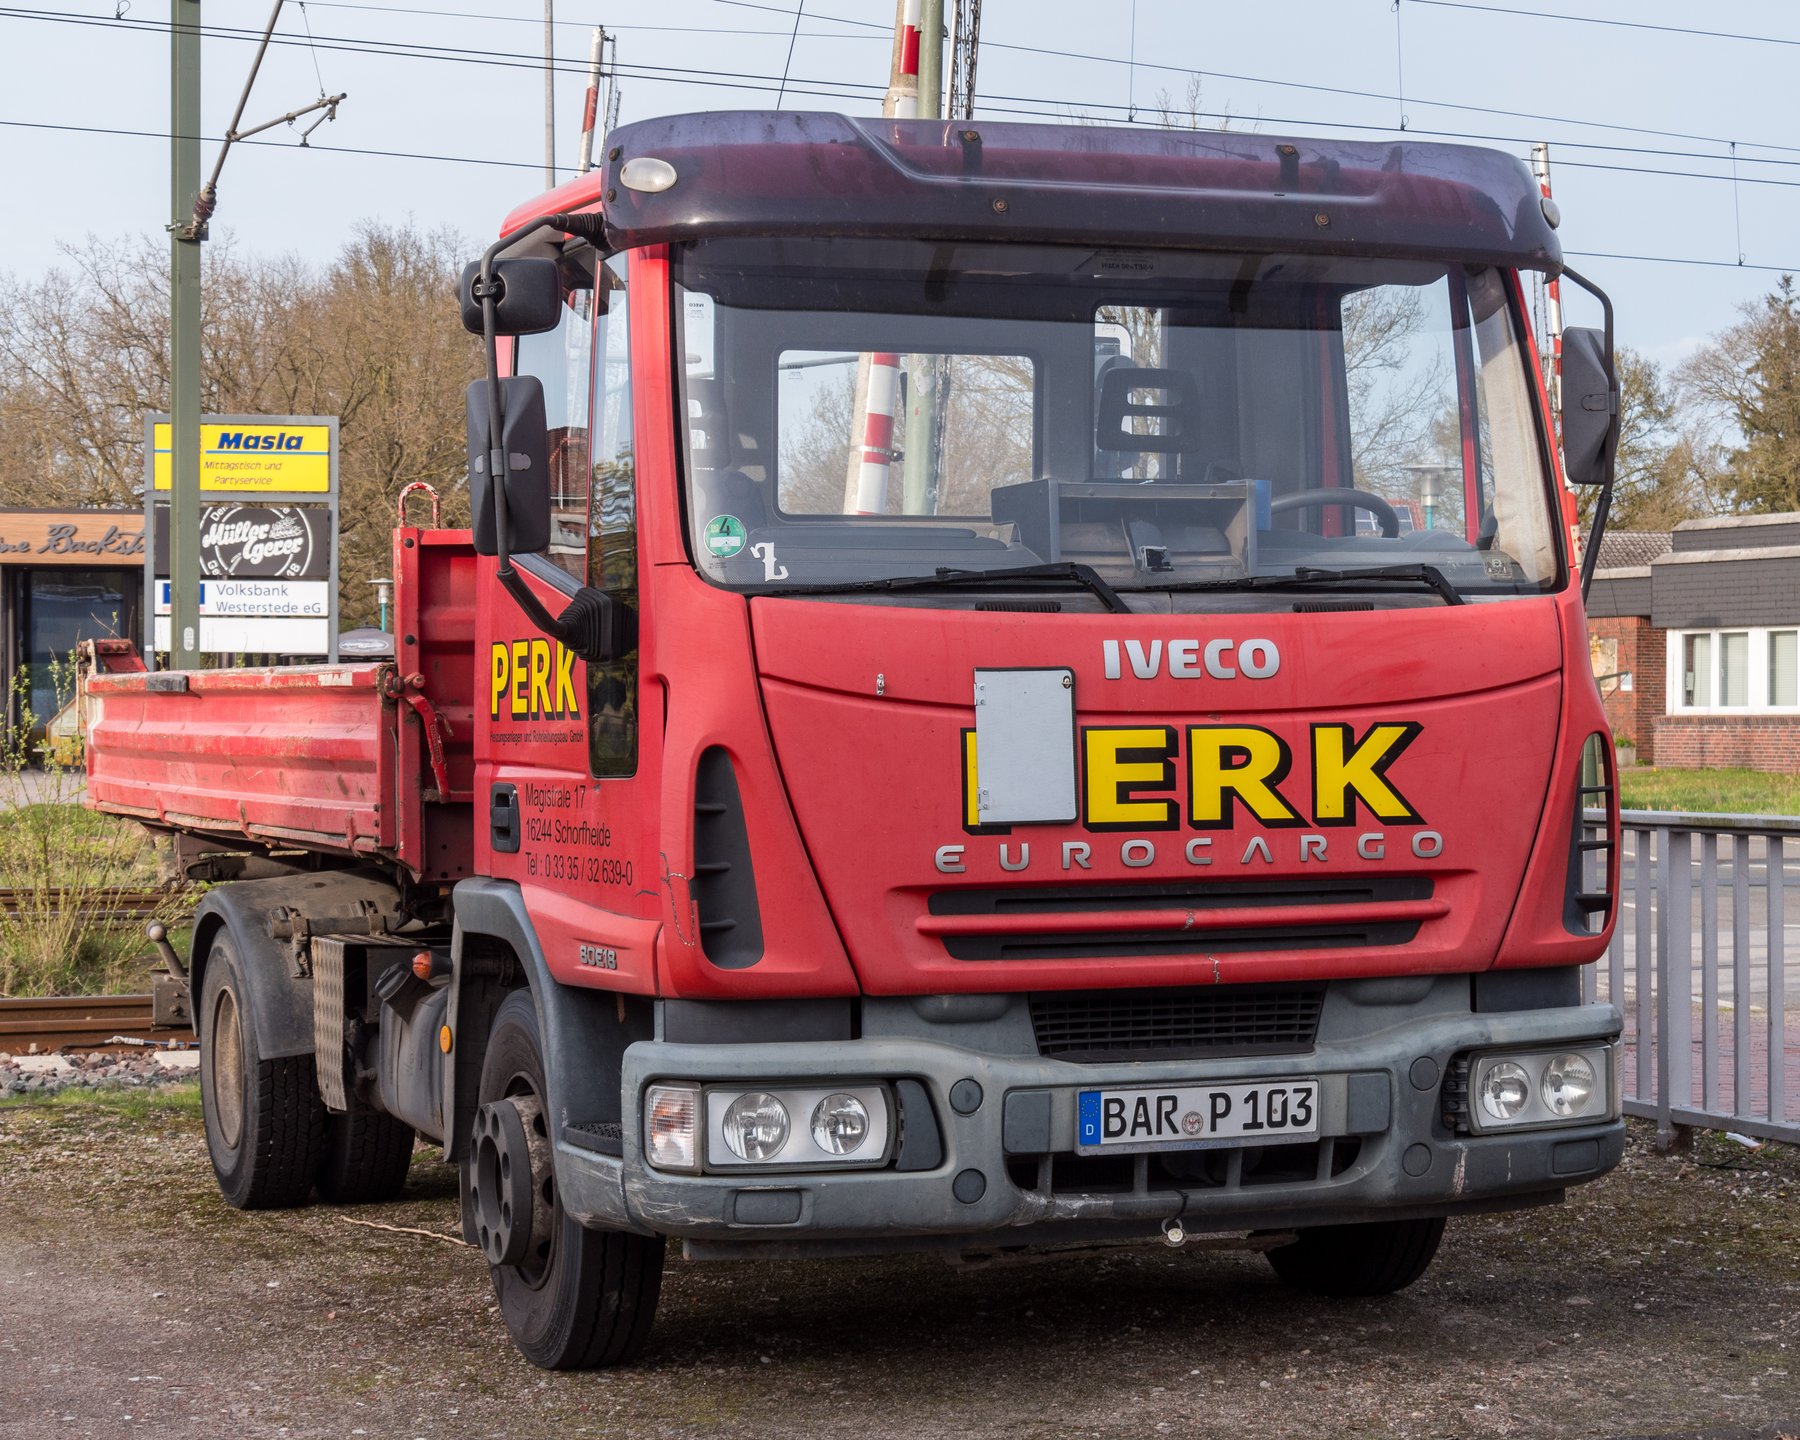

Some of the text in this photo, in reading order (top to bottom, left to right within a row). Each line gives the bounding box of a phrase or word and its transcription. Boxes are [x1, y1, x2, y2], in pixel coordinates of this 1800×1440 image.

[217, 432, 304, 450] Masla
[204, 461, 282, 471] Mittagstisch und
[214, 476, 273, 485] Partyservice
[202, 521, 270, 548] Müller
[719, 517, 731, 536] 4
[216, 584, 289, 596] Volksbank
[216, 601, 320, 613] Westerstede eG
[1102, 638, 1281, 680] IVECO
[491, 638, 581, 721] PERK
[961, 721, 1428, 836] ERK
[525, 783, 586, 813] Magistrale 17
[526, 818, 611, 847] 16244 Schorfheide
[934, 831, 1444, 872] EUROCARGO
[602, 859, 633, 886] 639-0
[1085, 1087, 1313, 1138] D BAR P 103
